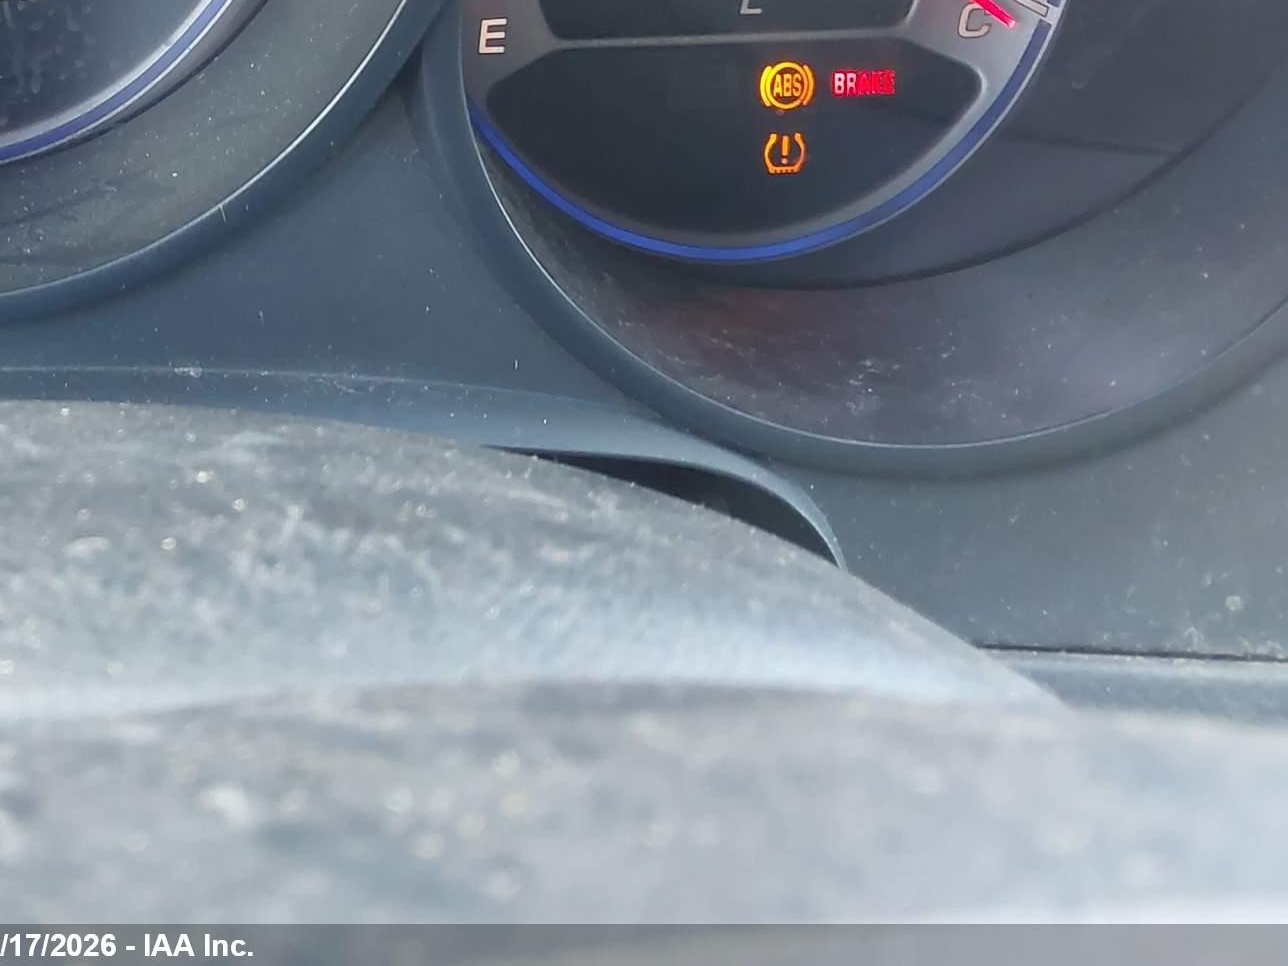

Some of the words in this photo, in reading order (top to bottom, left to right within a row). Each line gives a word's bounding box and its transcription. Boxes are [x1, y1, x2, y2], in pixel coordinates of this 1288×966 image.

[477, 17, 508, 55] E
[957, 2, 993, 38] C
[772, 73, 802, 97] ABS
